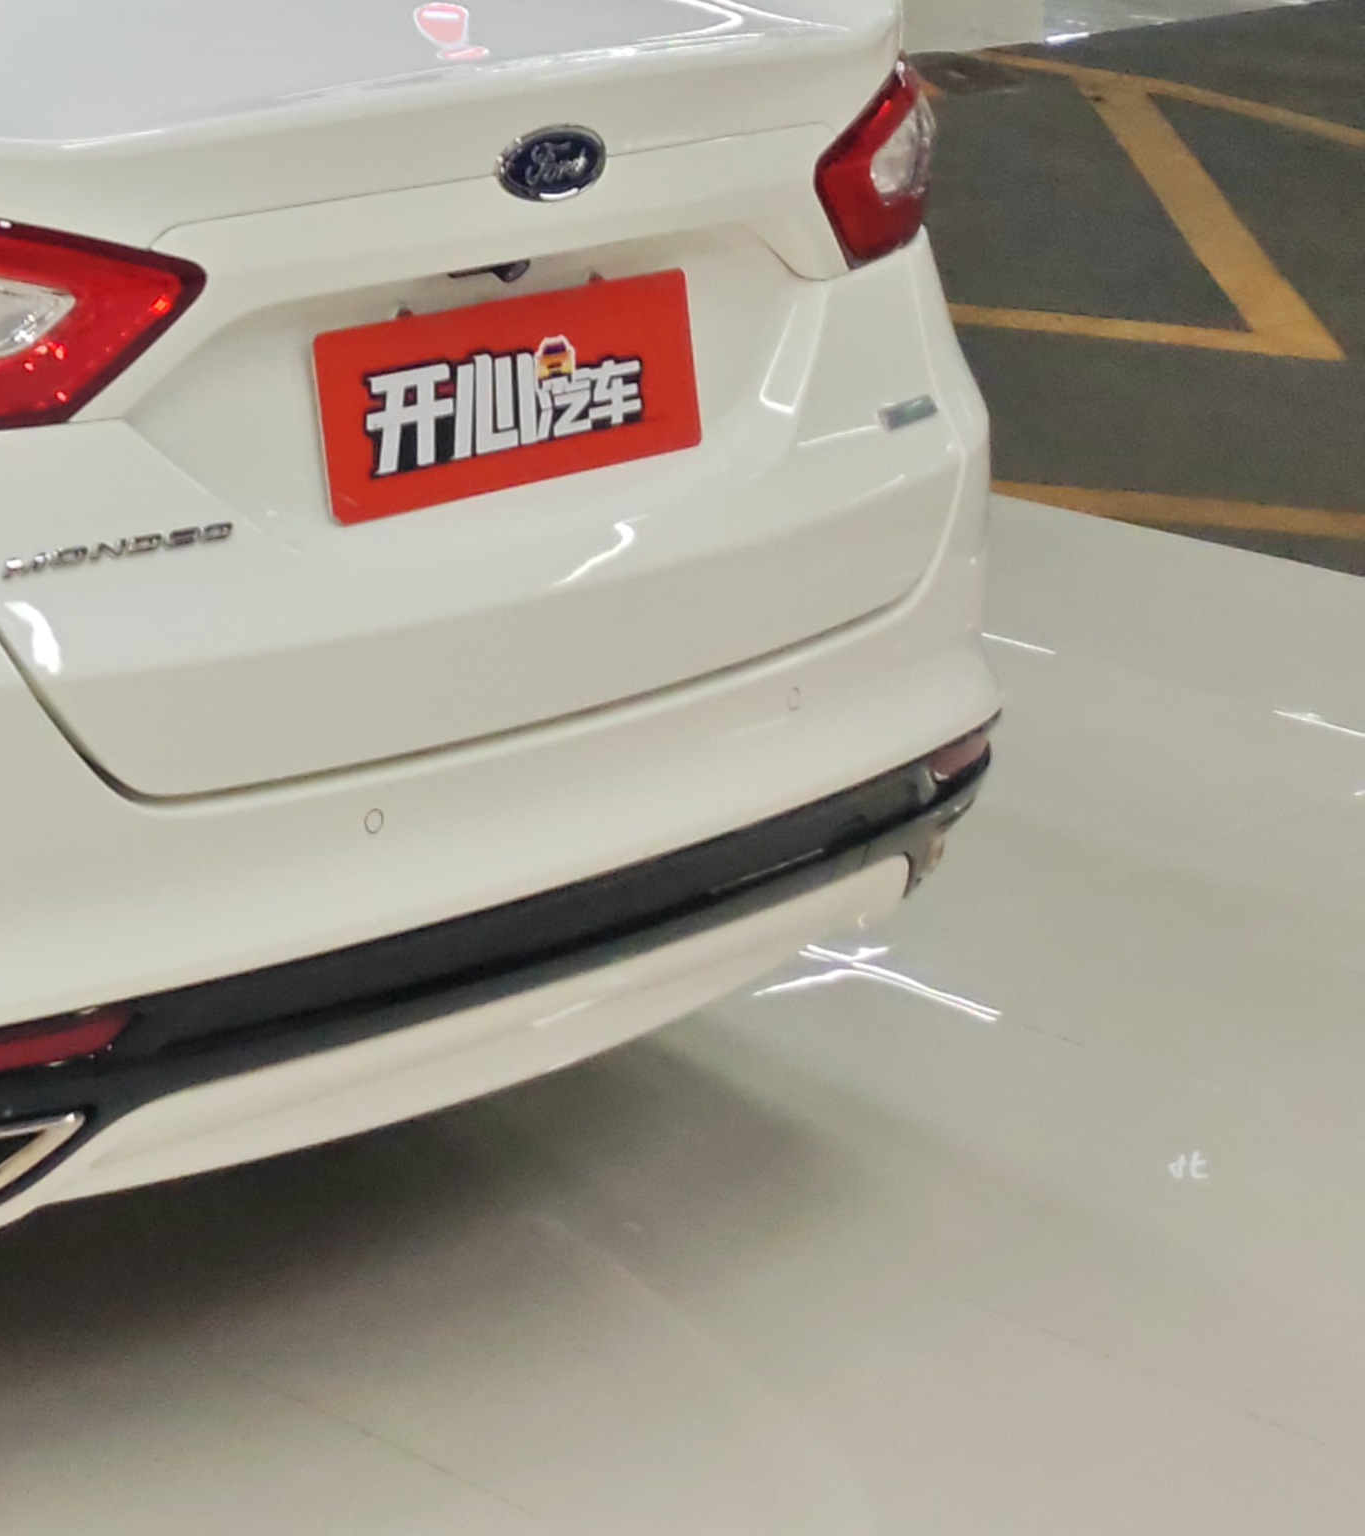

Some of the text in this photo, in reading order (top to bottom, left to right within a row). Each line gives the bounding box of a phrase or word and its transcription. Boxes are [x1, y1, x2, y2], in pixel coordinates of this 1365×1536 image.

[525, 142, 589, 185] Ford
[365, 352, 643, 477] 开心汽车
[1, 521, 233, 580] MONDEO
